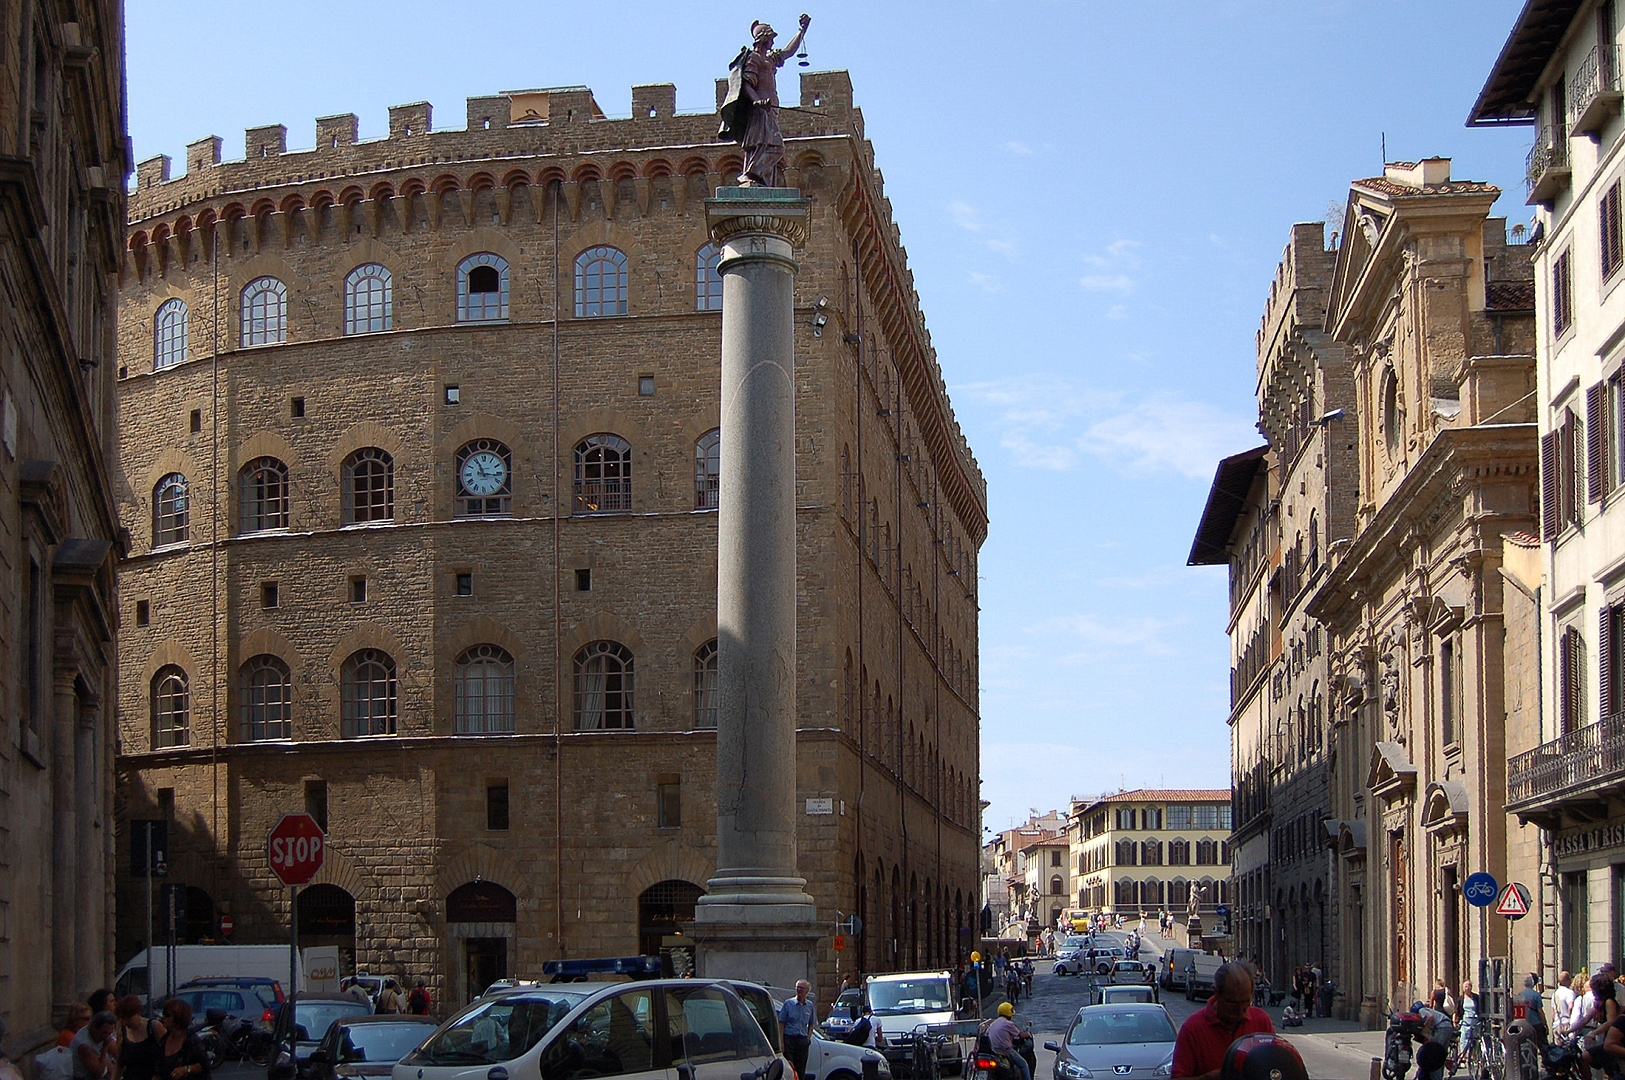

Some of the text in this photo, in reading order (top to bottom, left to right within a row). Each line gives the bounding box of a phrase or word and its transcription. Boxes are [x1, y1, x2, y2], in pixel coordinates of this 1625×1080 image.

[272, 836, 321, 865] STOP
[1553, 834, 1585, 857] CASSA
[1587, 830, 1600, 850] DI
